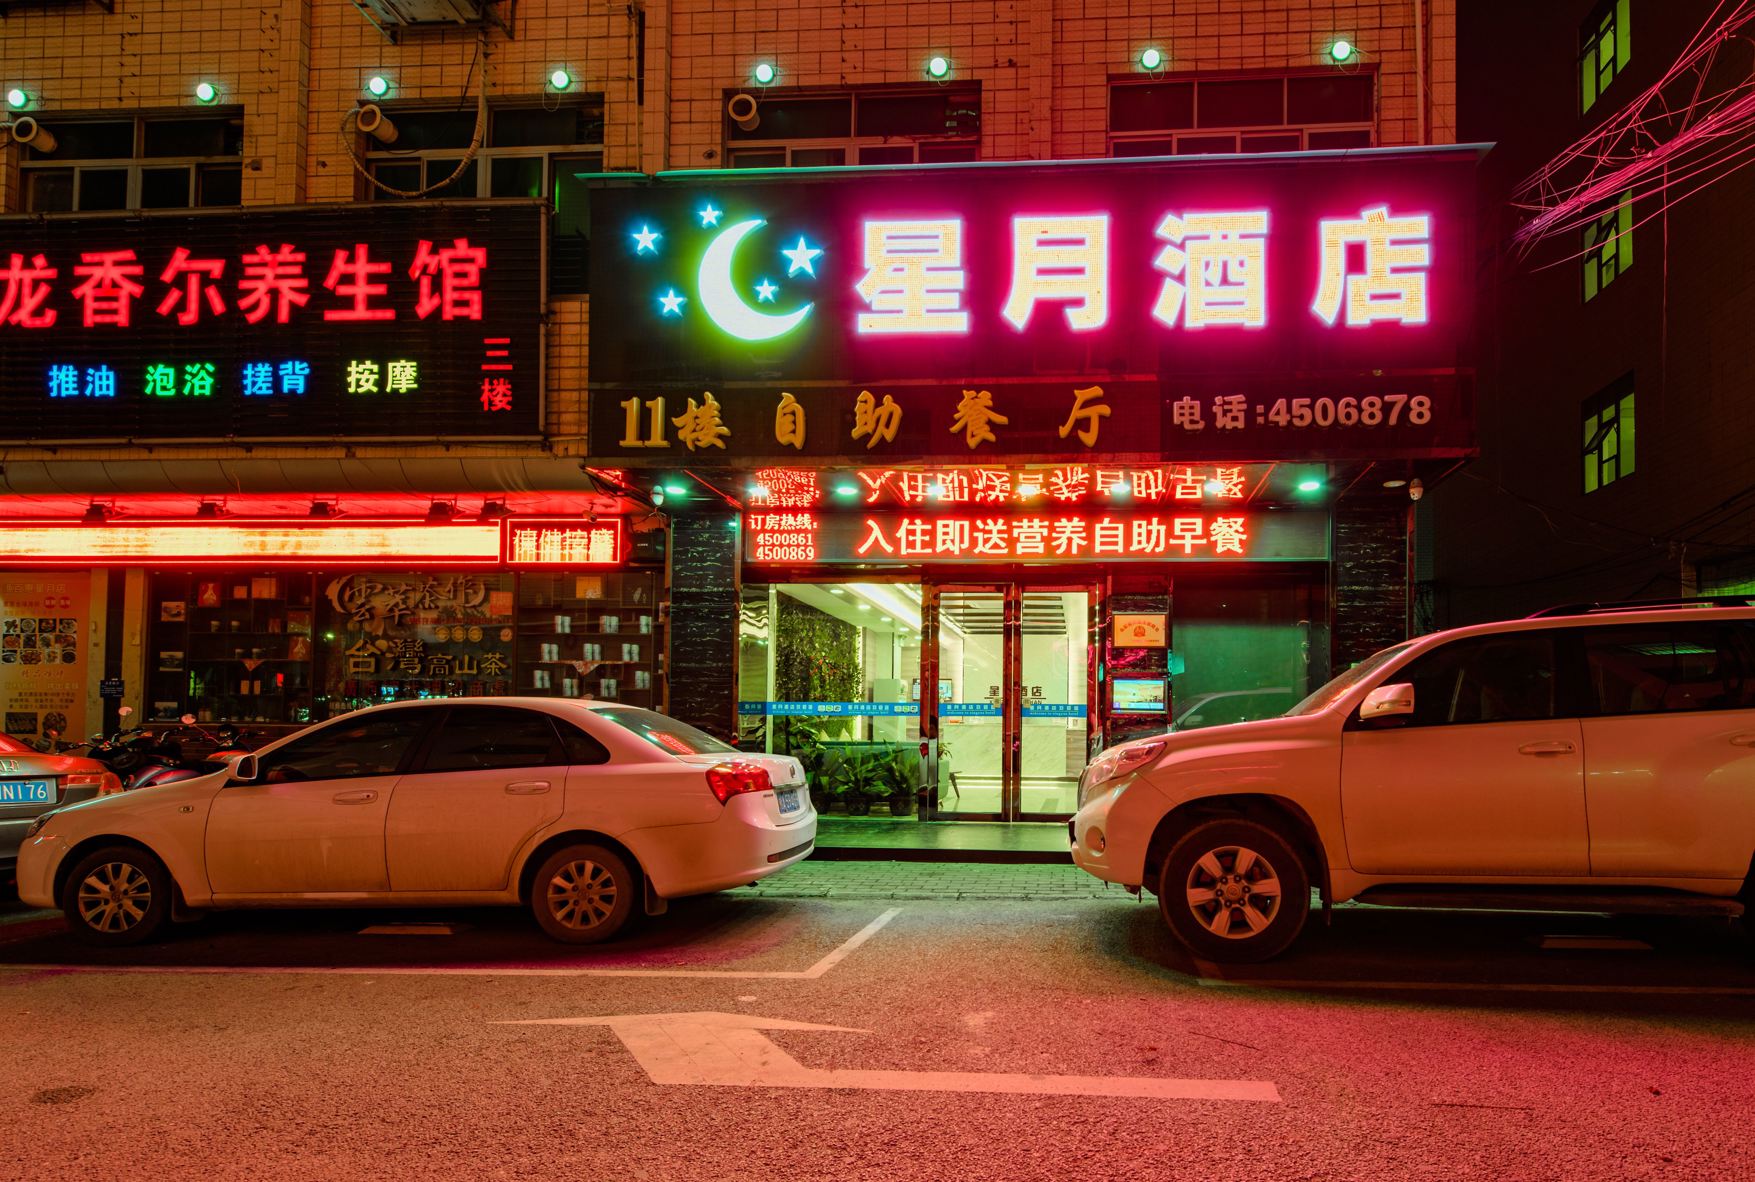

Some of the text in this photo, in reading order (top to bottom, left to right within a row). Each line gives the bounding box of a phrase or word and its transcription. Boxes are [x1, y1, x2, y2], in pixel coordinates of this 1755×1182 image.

[0, 238, 487, 329] 龙香尔养生馆
[855, 205, 1432, 334] 星月酒店
[48, 359, 419, 398] 推油 泡浴 搓背 按摩
[480, 337, 513, 413] 三楼
[756, 546, 815, 561] 4500869
[757, 533, 814, 546] 4500861
[856, 516, 1248, 556] 入住即送营养自助早餐
[0, 784, 47, 800] N176
